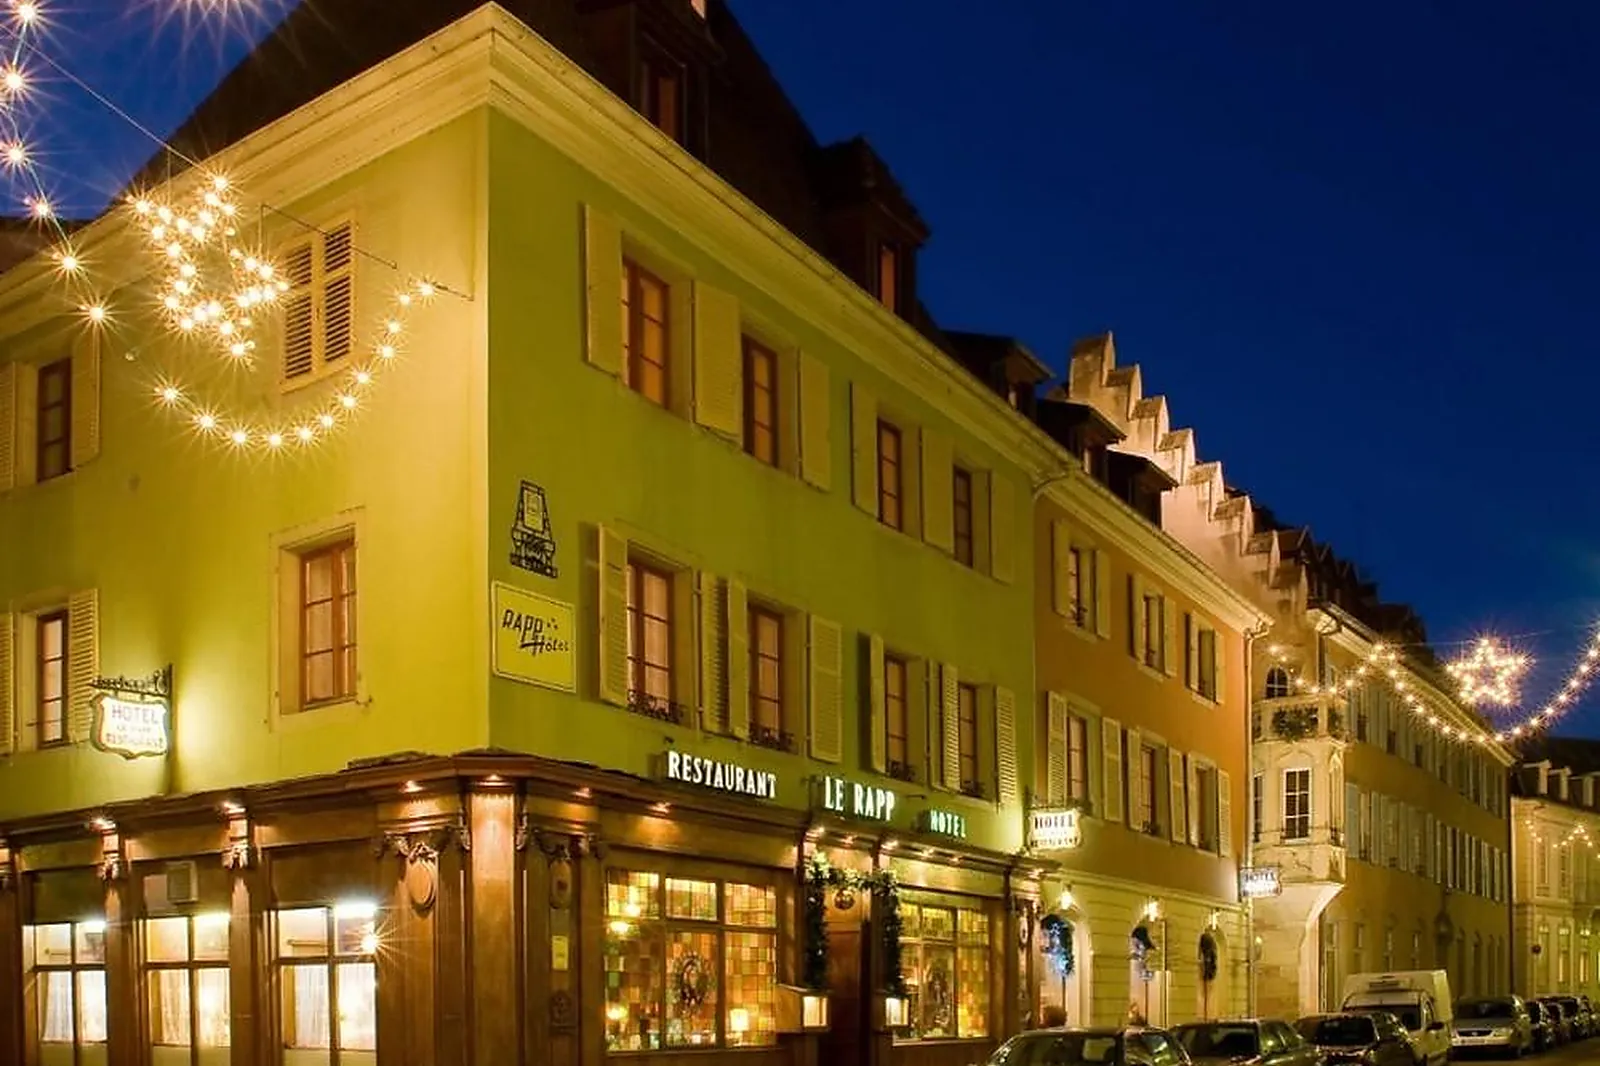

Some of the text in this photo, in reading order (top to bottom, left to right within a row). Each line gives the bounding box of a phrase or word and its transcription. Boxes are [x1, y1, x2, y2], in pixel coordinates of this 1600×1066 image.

[502, 609, 543, 643] RAPP
[111, 704, 158, 725] HOTEL
[667, 750, 777, 799] RESTAURANT
[824, 775, 895, 821] LE RAPP
[929, 808, 966, 838] HOTEL
[1034, 813, 1076, 830] HOTEL
